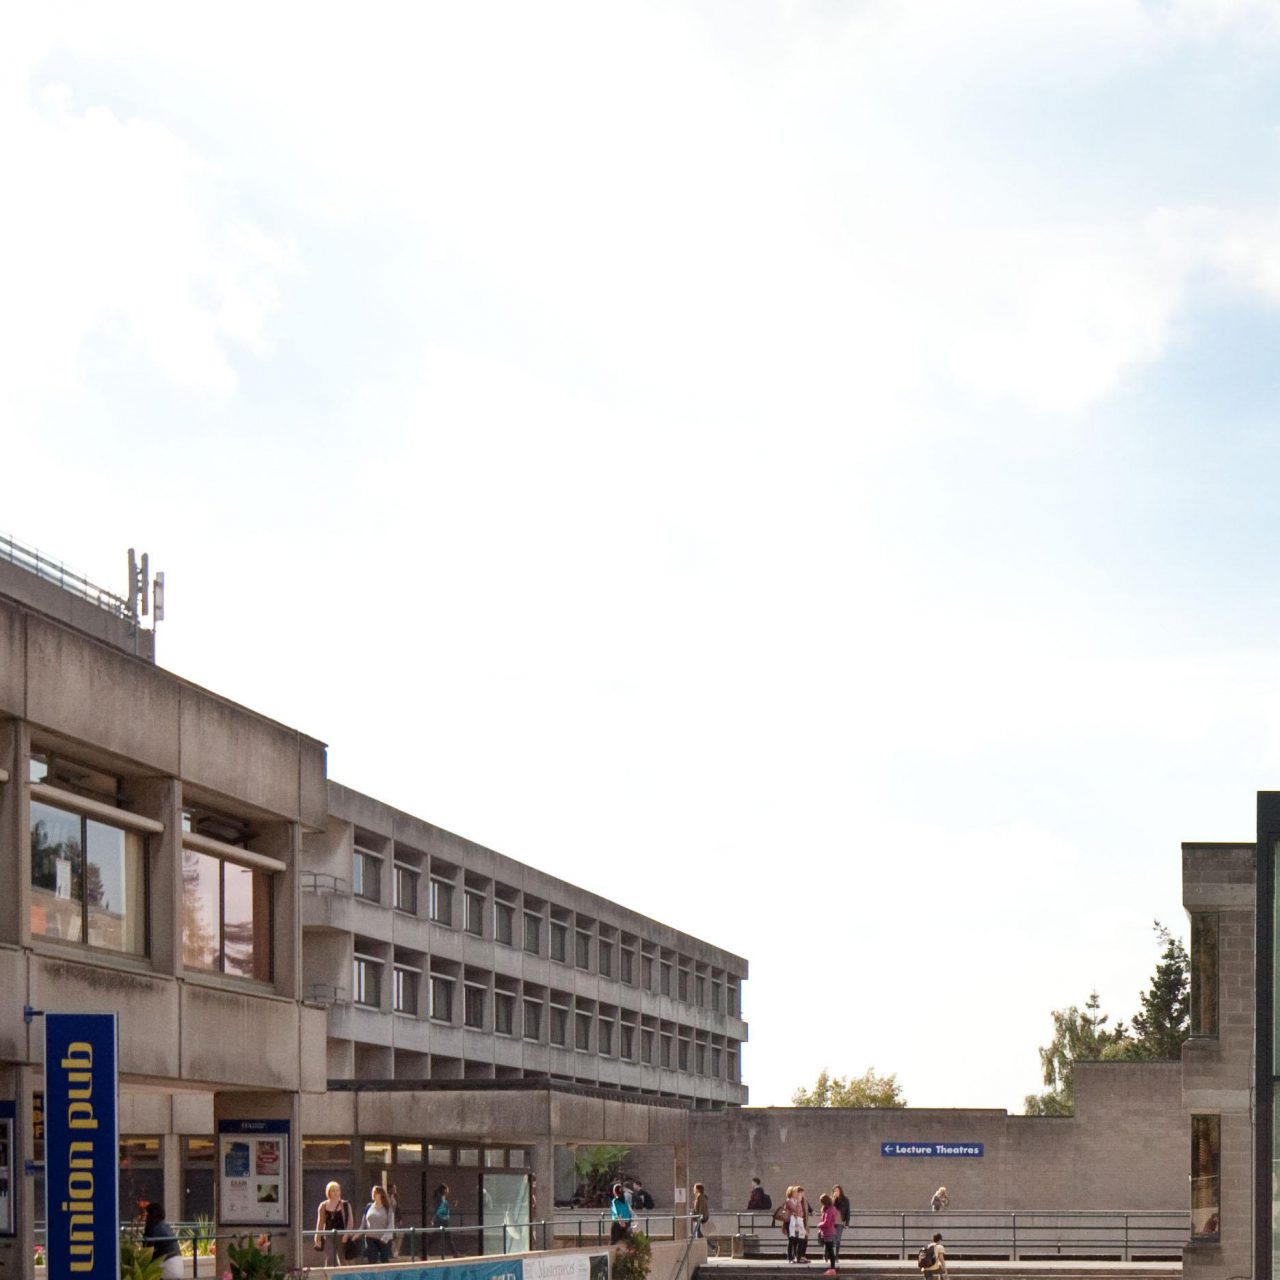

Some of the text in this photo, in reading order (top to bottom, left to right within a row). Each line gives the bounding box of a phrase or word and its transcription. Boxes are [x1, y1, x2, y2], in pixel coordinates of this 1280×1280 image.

[61, 1041, 98, 1272] union pub
[896, 1145, 979, 1154] Lecture Theatres
